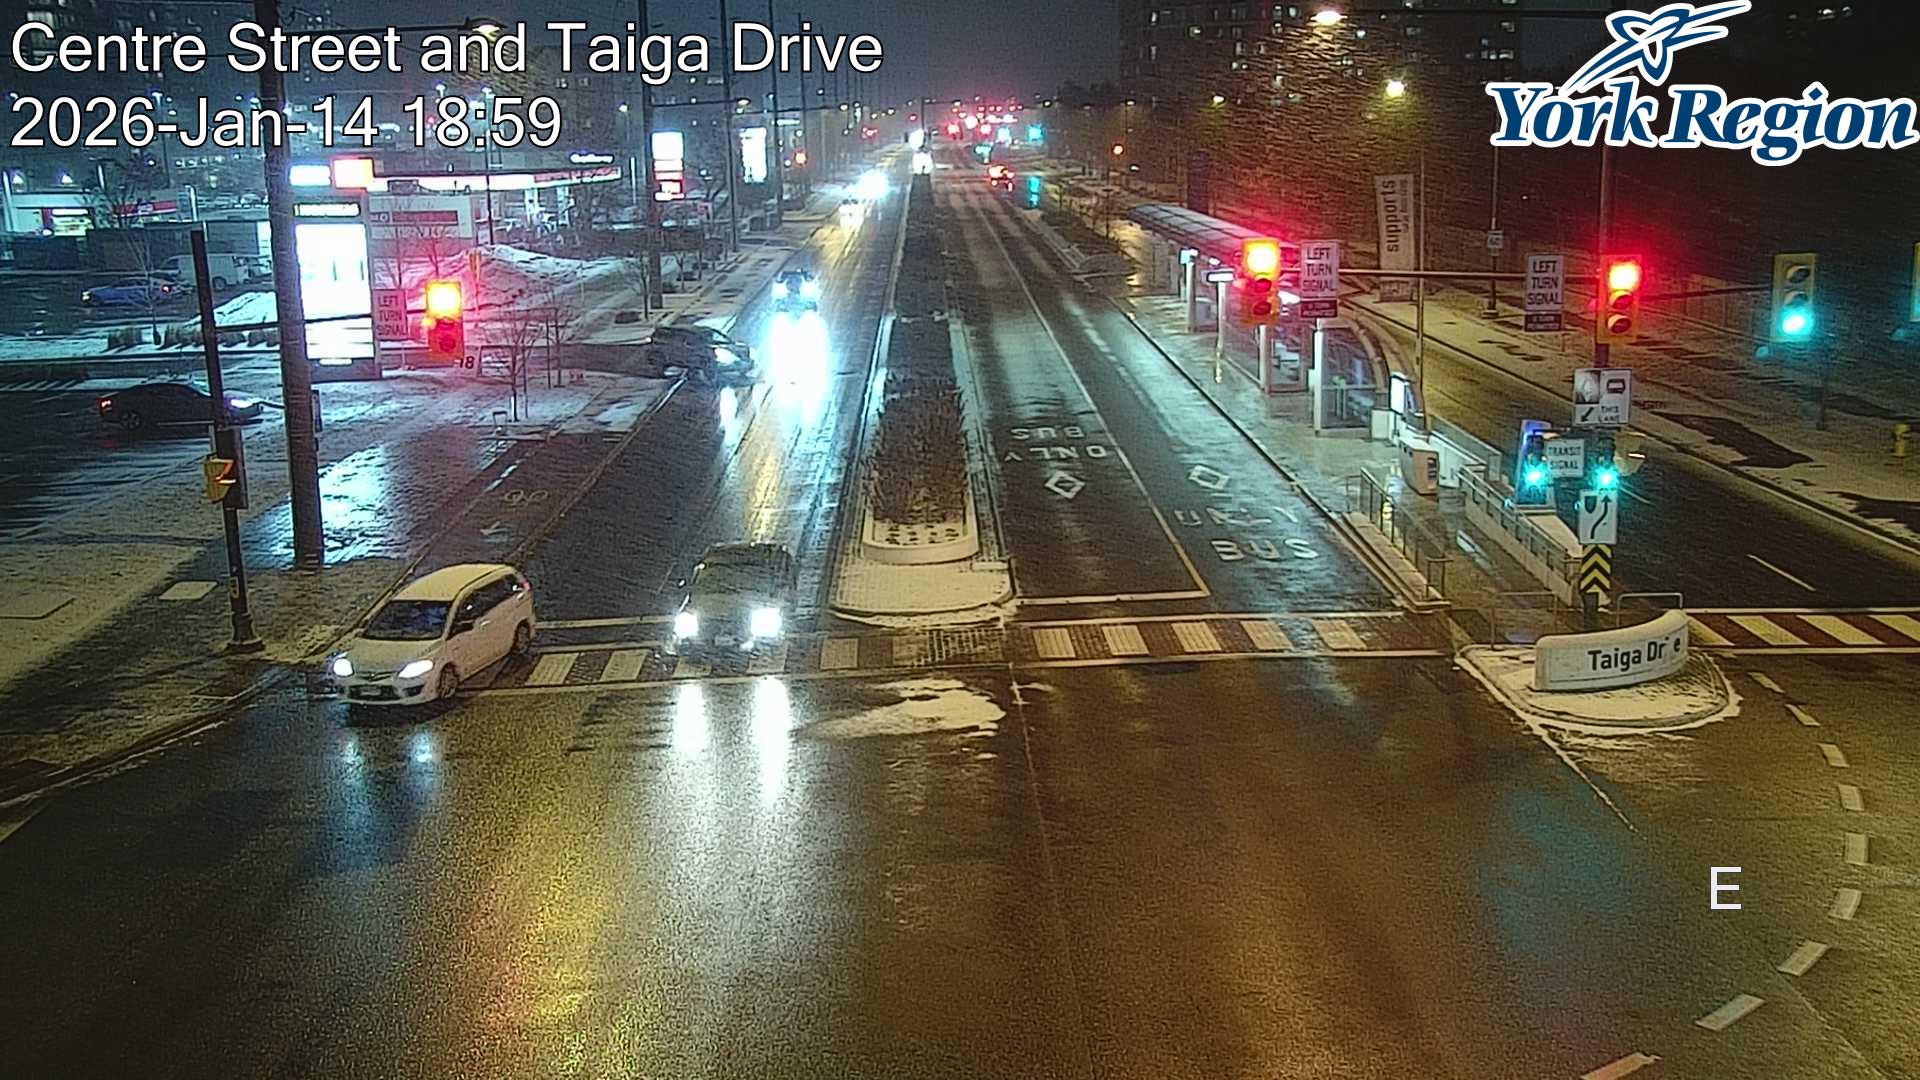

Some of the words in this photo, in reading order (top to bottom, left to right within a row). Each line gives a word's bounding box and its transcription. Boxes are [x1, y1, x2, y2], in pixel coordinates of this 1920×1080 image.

[1381, 179, 1402, 253] supports
[1306, 247, 1331, 260] LEFT
[1306, 263, 1332, 276] TURN
[1533, 260, 1557, 273] LEFT
[1532, 276, 1559, 289] TURN
[1527, 292, 1563, 305] SIGNAL
[1010, 426, 1085, 440] BUS
[1004, 445, 1107, 462] ONLY
[1548, 446, 1581, 457] TRANSIT
[1210, 538, 1319, 561] BUS
[1587, 647, 1642, 672] Taiga
[1647, 636, 1681, 662] Dre
